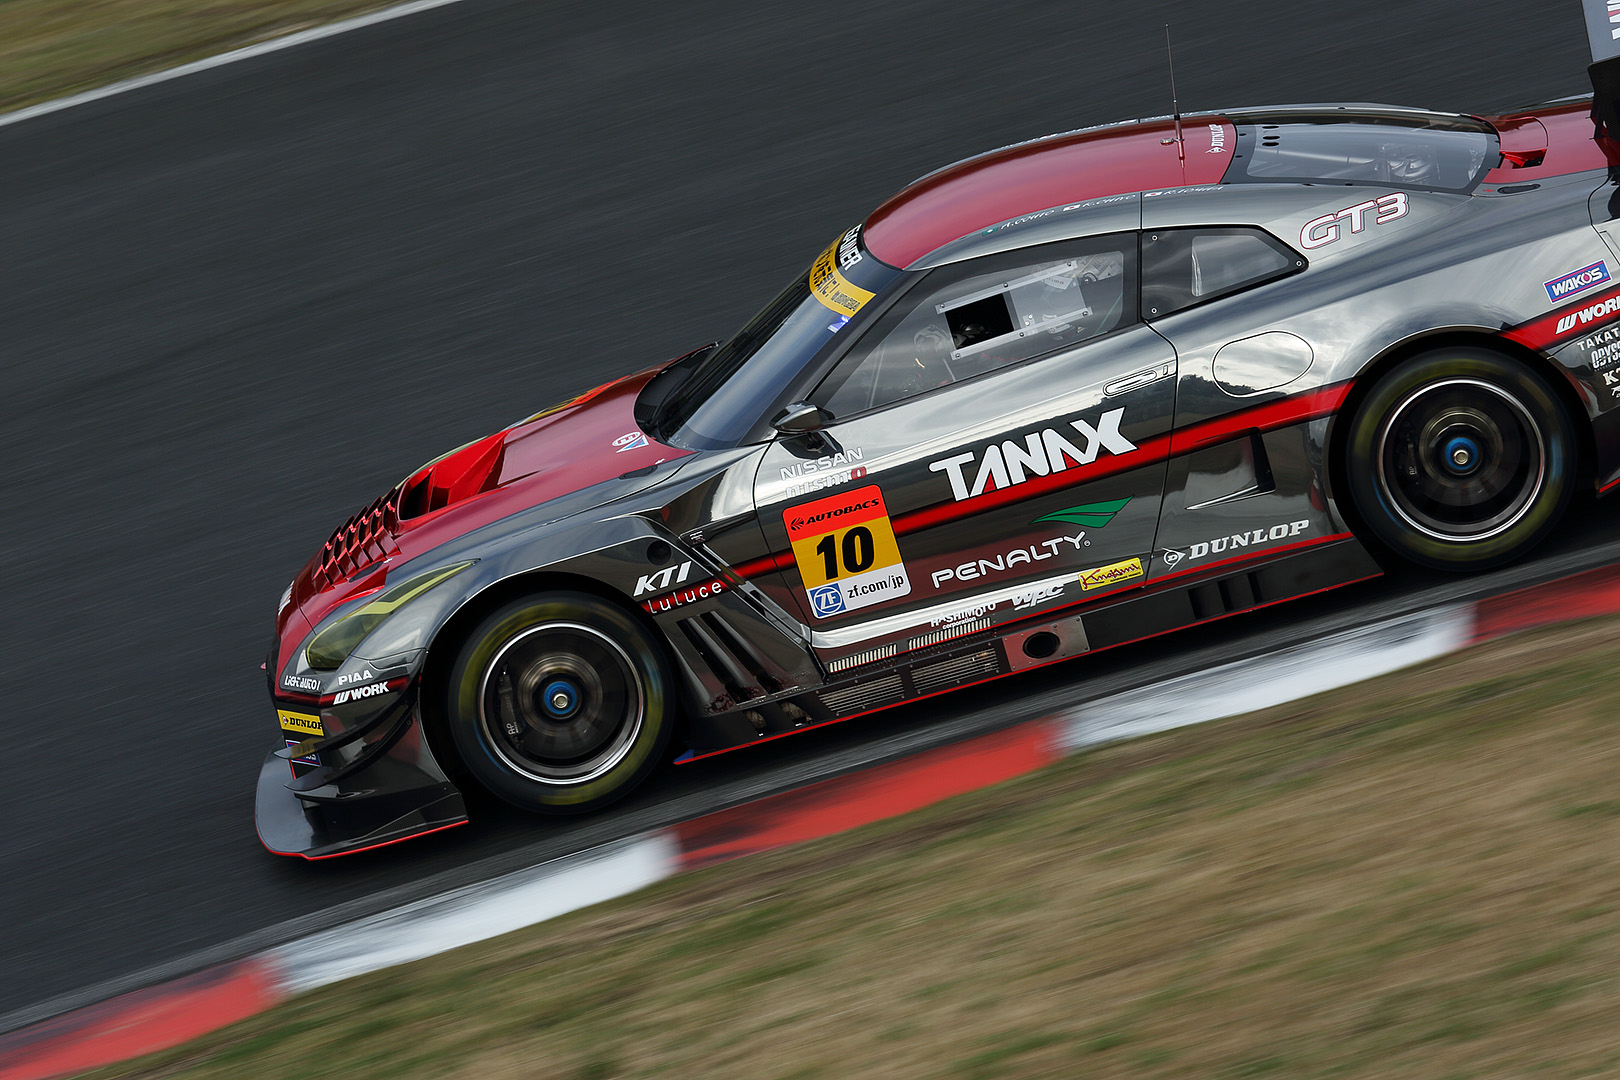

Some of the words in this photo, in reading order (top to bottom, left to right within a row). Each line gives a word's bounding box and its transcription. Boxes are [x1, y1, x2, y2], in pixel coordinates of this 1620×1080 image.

[1299, 191, 1410, 250] GT3
[779, 447, 864, 481] NISSAN
[928, 406, 1138, 501] TANAX
[785, 466, 867, 500] nismo
[806, 498, 880, 525] AUTOBACS
[816, 526, 875, 581] 10
[1188, 519, 1310, 560] DUNLOP
[931, 530, 1086, 589] PENALTY
[633, 560, 692, 597] KTI
[847, 574, 904, 599] zf.com/jp
[647, 582, 722, 614] luluce
[816, 592, 838, 610] ZF
[930, 602, 997, 627] HASHIMOTO
[338, 669, 373, 686] PIAA
[350, 681, 389, 701] WORK
